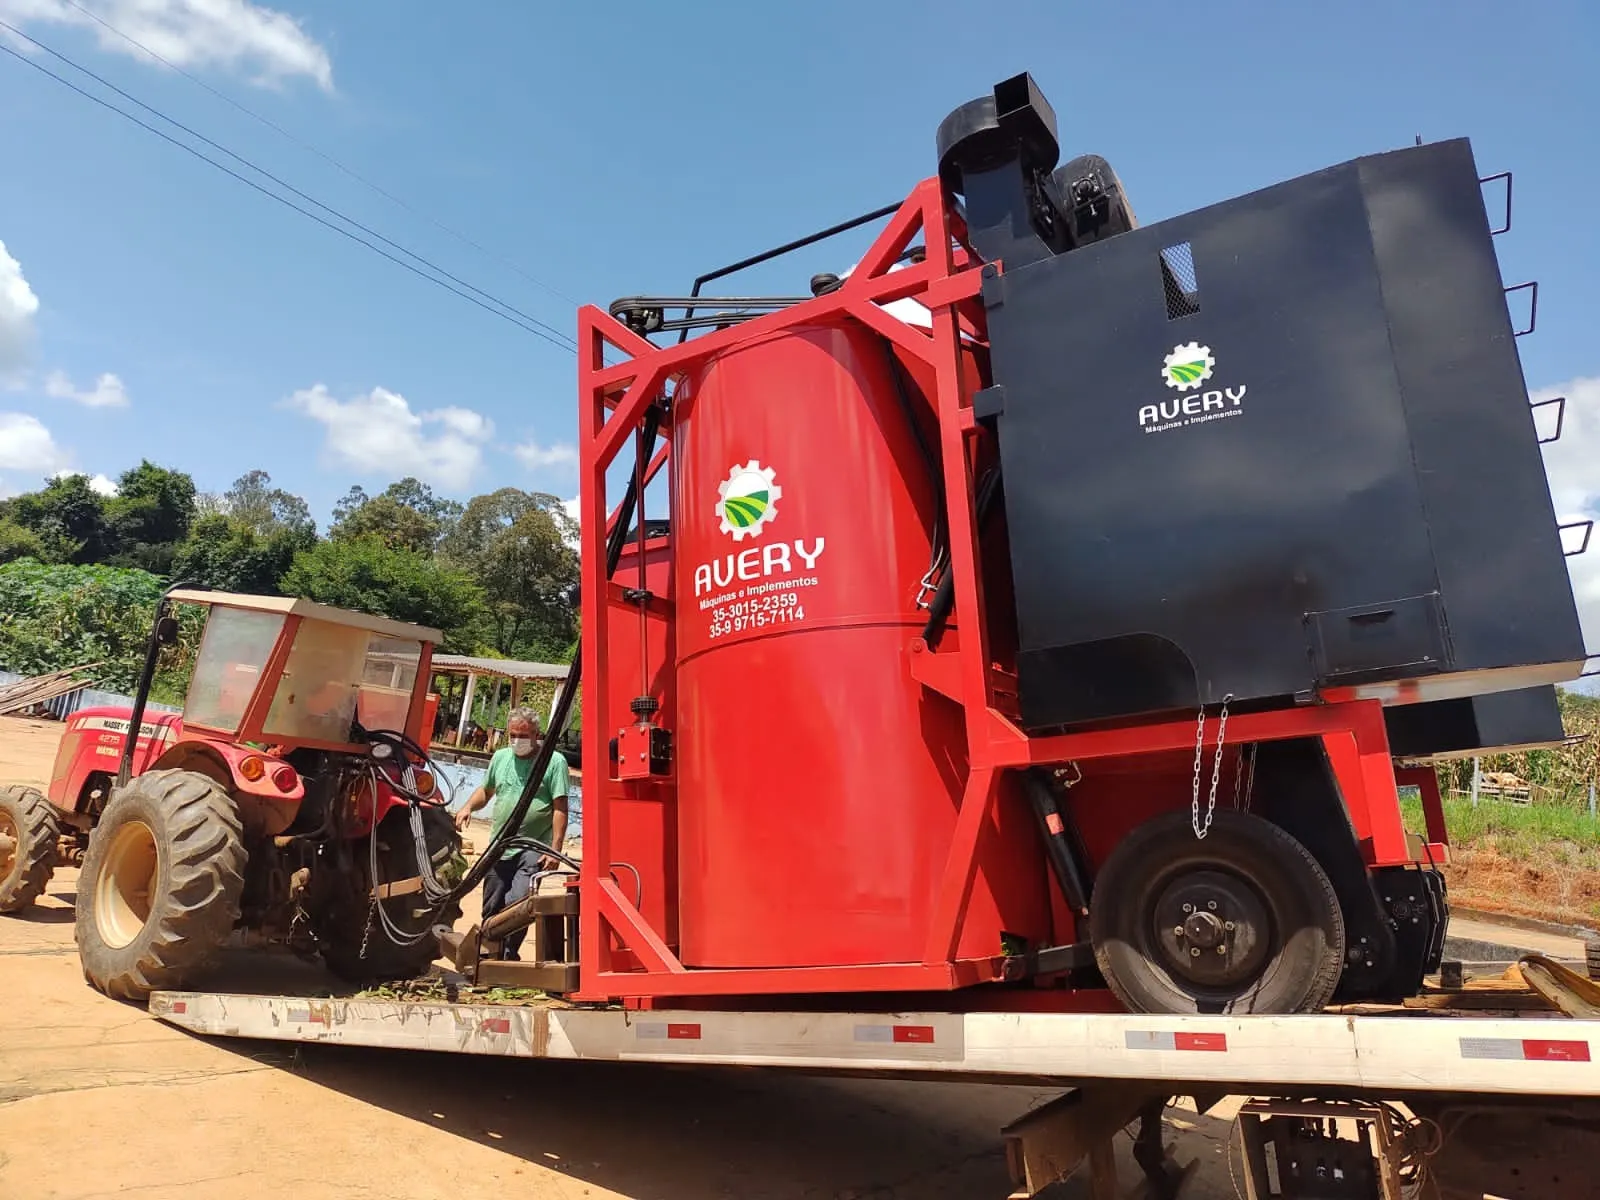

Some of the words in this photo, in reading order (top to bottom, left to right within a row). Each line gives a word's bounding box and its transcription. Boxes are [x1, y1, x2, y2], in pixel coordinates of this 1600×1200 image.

[1139, 385, 1246, 425] AVERY
[1190, 410, 1242, 423] Implementos
[694, 537, 825, 597] AVERY
[700, 592, 736, 610] Máquinas
[738, 589, 745, 599] e
[747, 576, 818, 595] Implementos
[712, 593, 797, 623] 35-3015-2359
[709, 621, 731, 638] 35-9
[735, 606, 804, 632] 9715-7114
